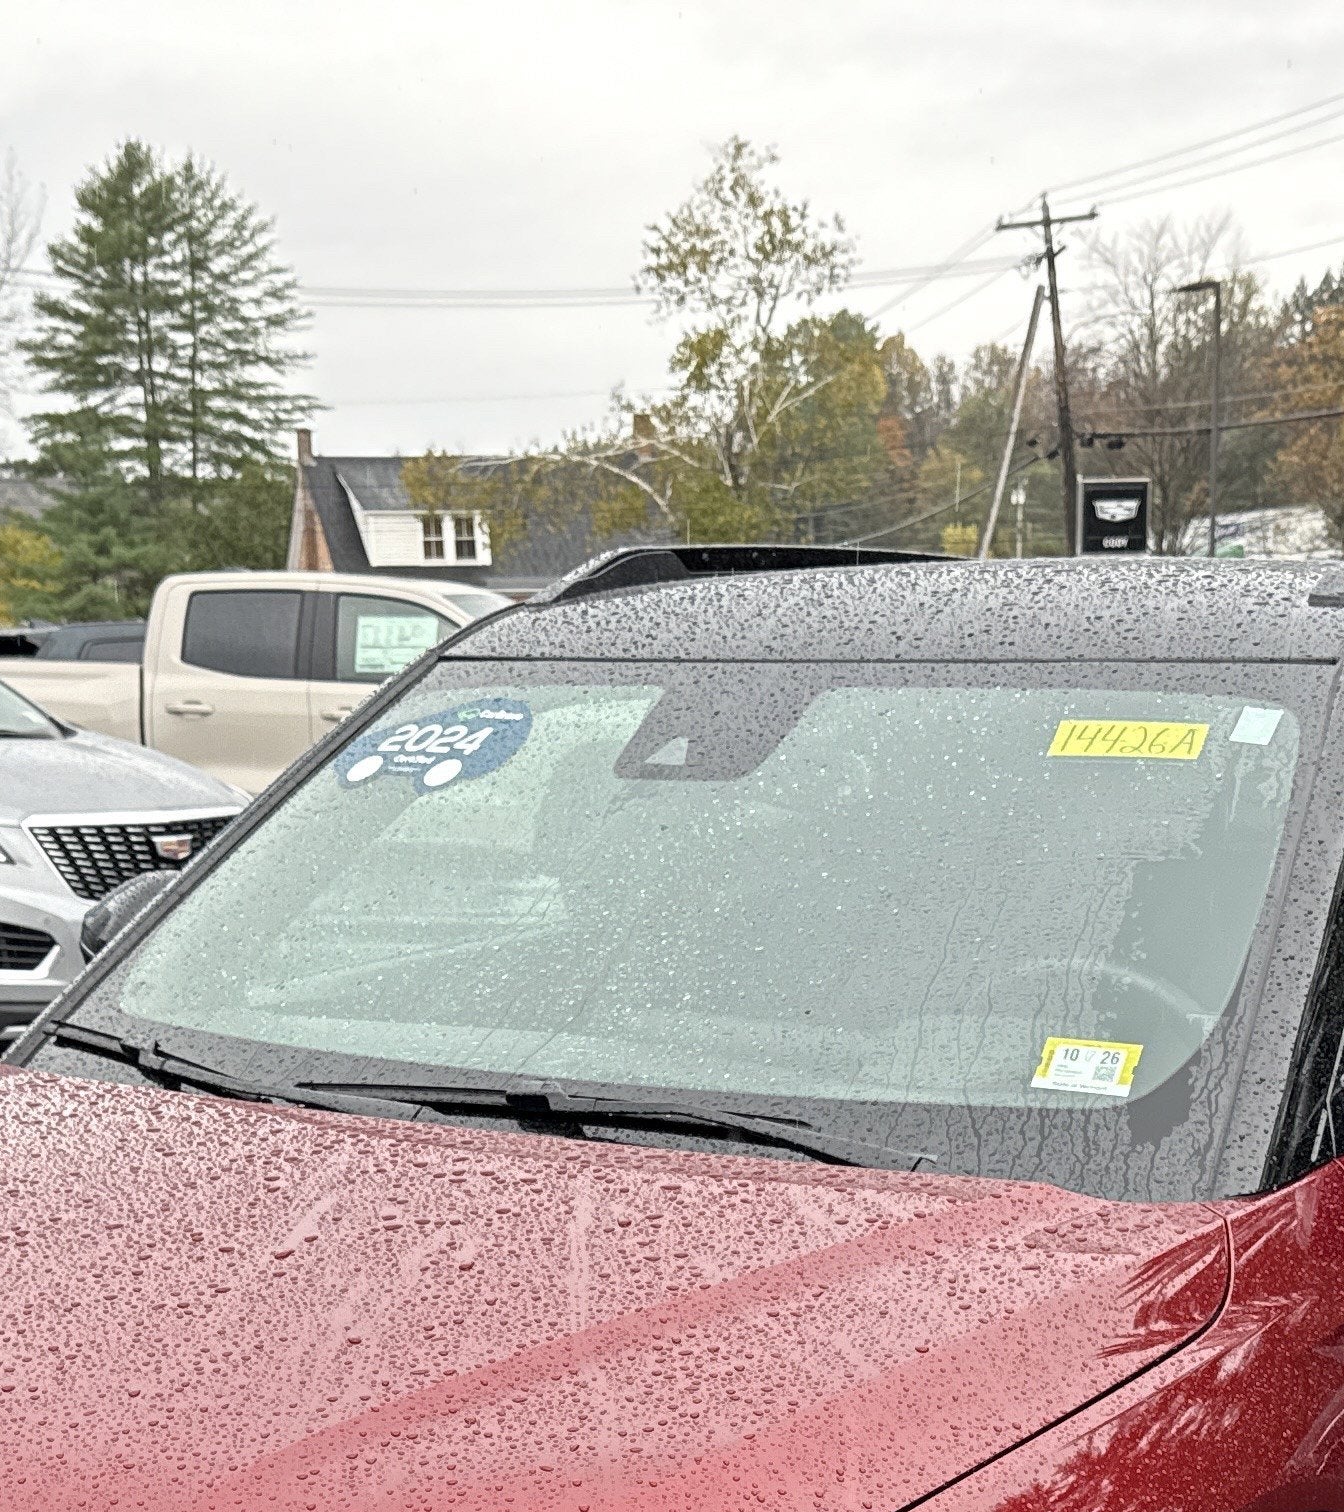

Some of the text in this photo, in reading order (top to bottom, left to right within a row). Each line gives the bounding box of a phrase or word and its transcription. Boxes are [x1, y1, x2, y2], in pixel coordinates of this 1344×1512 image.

[377, 723, 494, 755] 2024
[1060, 724, 1199, 755] 14426A
[1062, 1048, 1121, 1065] 10 26
